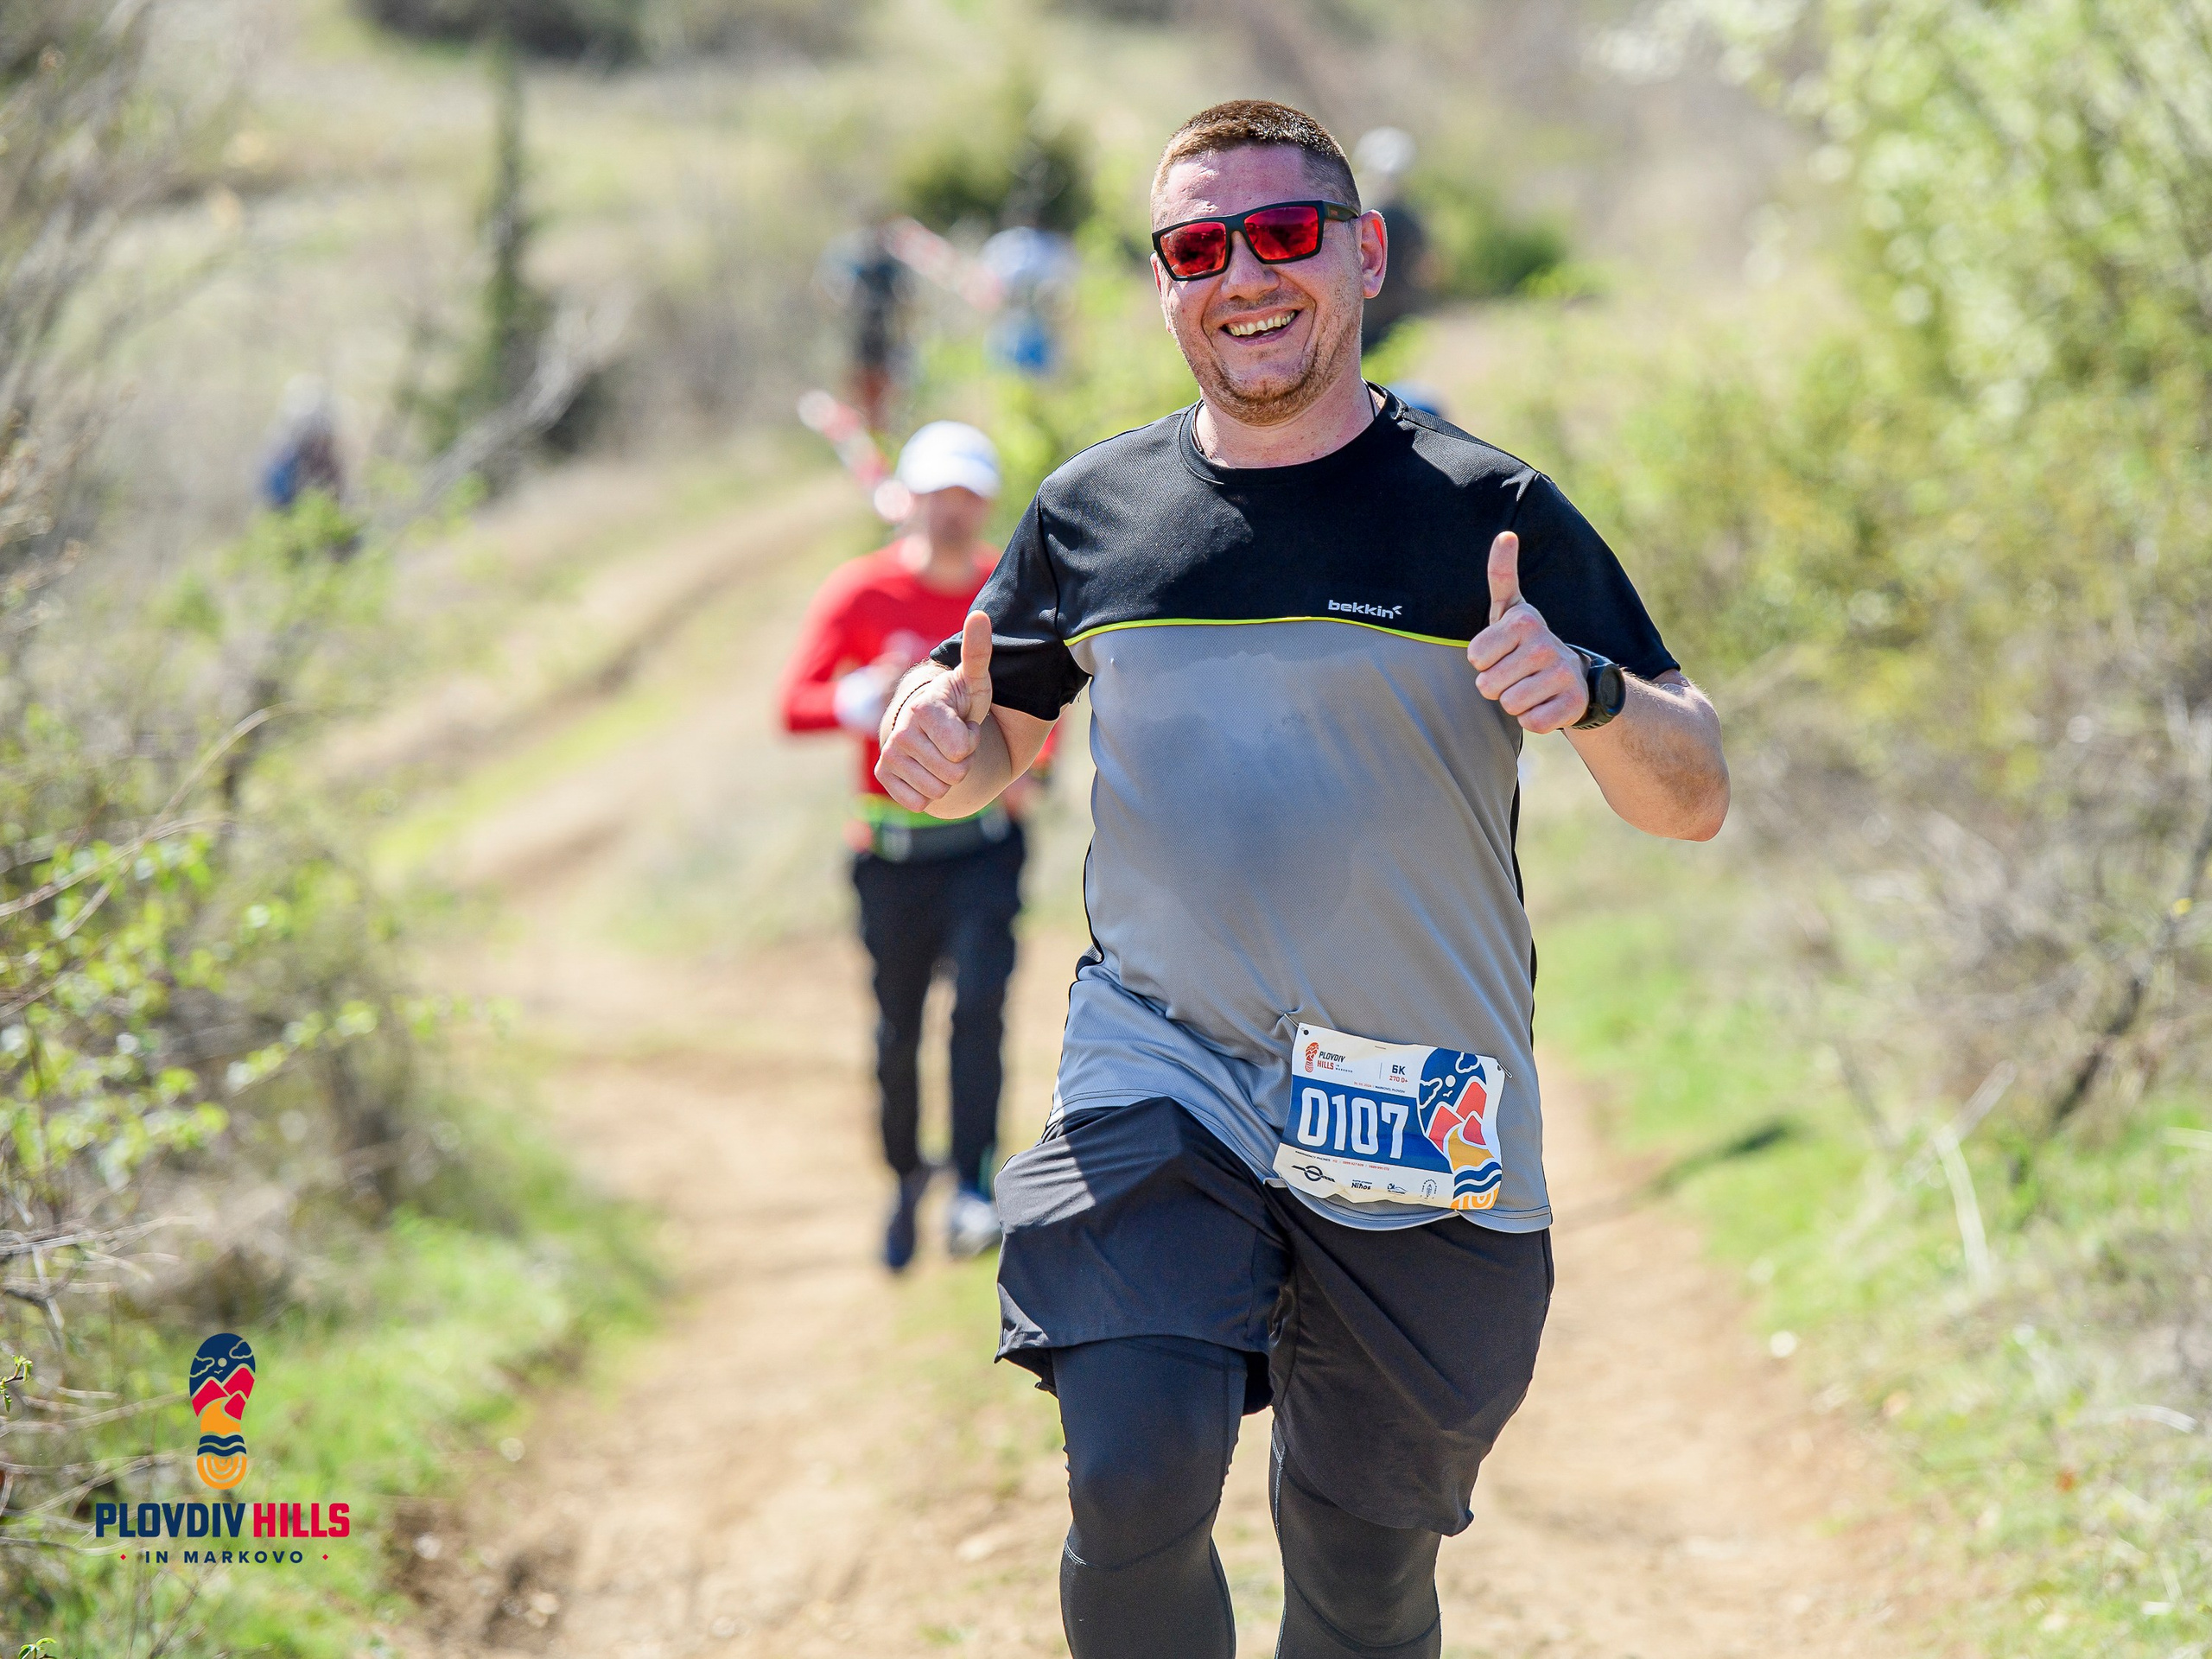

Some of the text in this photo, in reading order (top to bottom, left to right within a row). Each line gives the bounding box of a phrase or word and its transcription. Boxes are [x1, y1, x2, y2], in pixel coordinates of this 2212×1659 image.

[1328, 600, 1394, 620] bekkin
[1318, 1051, 1346, 1063] PLOVDIV
[1317, 1060, 1334, 1071] HILLS
[1391, 1064, 1406, 1076] 6K
[1297, 1087, 1409, 1160] 0107
